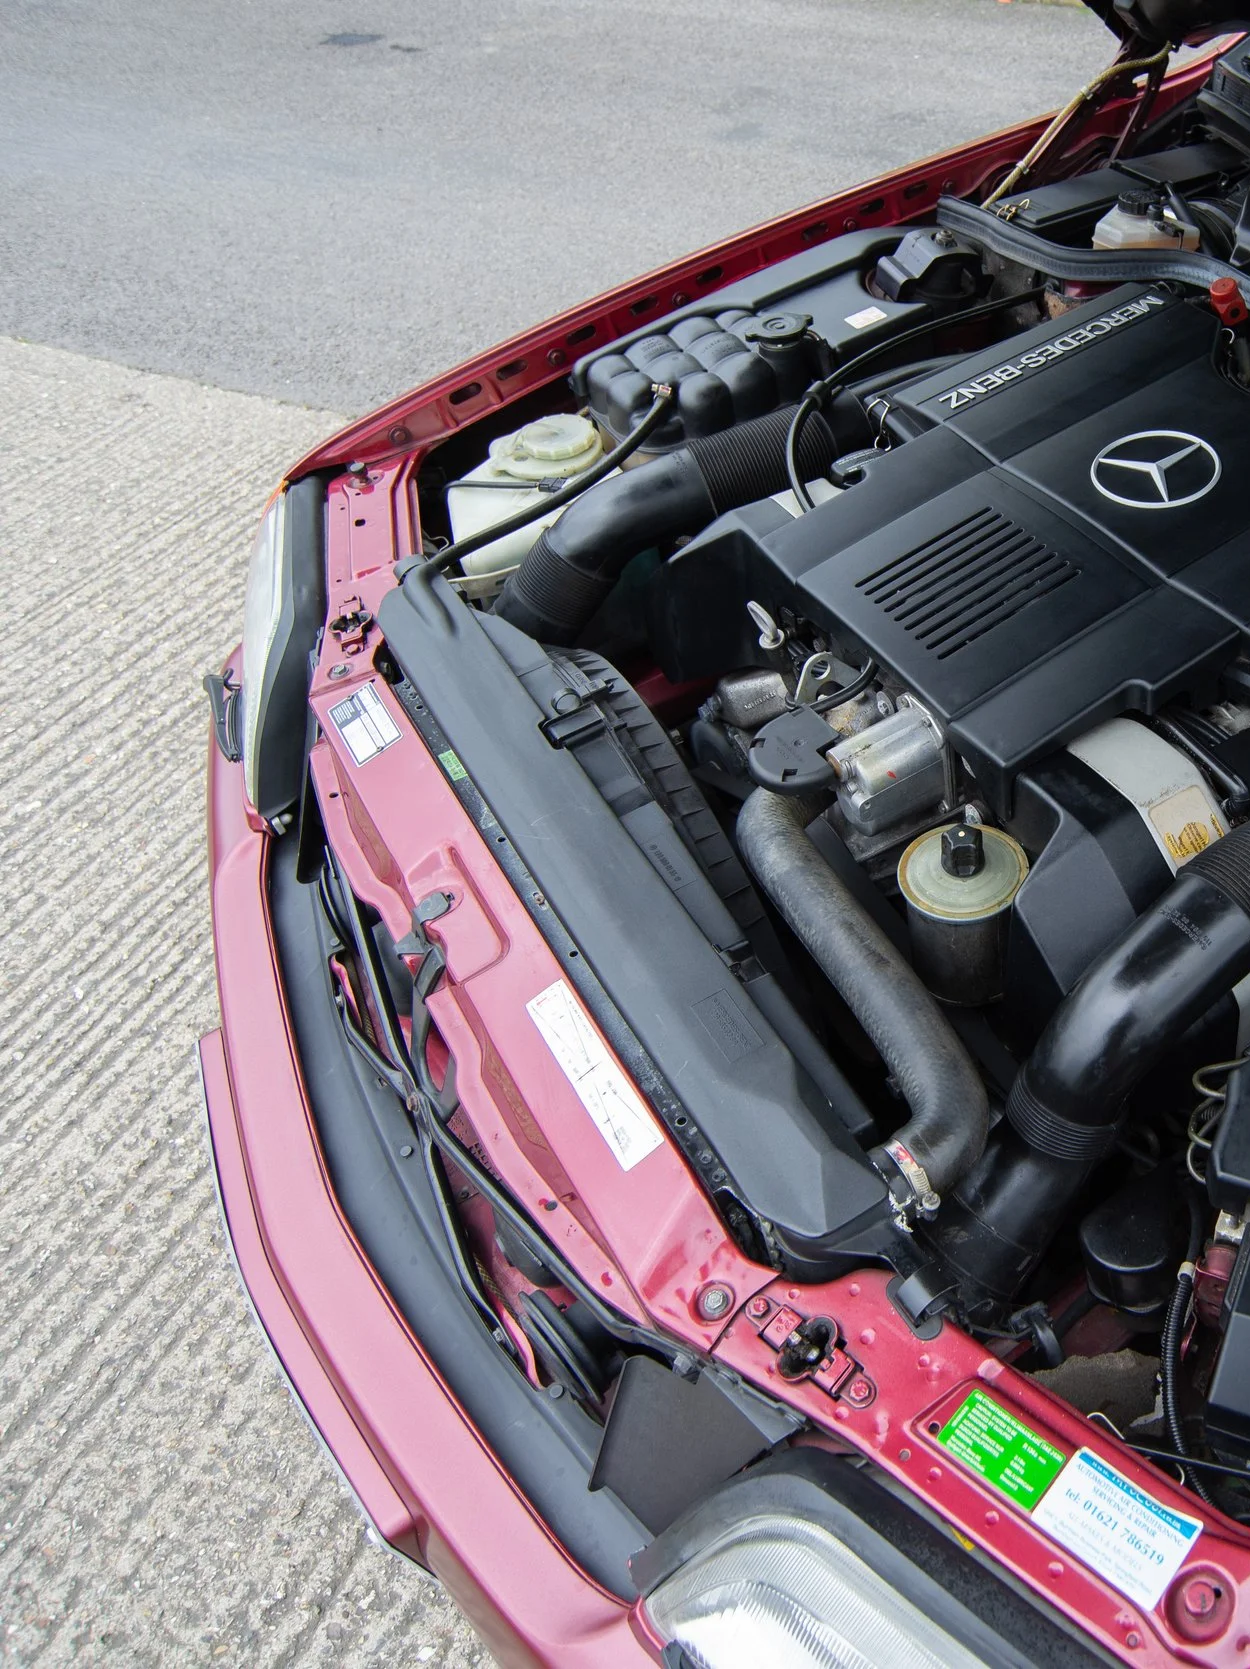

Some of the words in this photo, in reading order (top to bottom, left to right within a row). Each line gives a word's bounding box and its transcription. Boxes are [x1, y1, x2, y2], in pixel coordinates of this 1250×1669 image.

[939, 294, 1165, 411] MERCEDES-BENZ
[1064, 1487, 1083, 1504] tel:
[1081, 1499, 1120, 1532] 01621
[1118, 1527, 1166, 1567] 786519
[1075, 1463, 1119, 1498] AUTOMOTIVE
[1119, 1495, 1131, 1507] AIR
[1131, 1504, 1185, 1548] CONDITIONING
[1091, 1486, 1127, 1516] SERVICING
[1133, 1519, 1157, 1539] REPAIR
